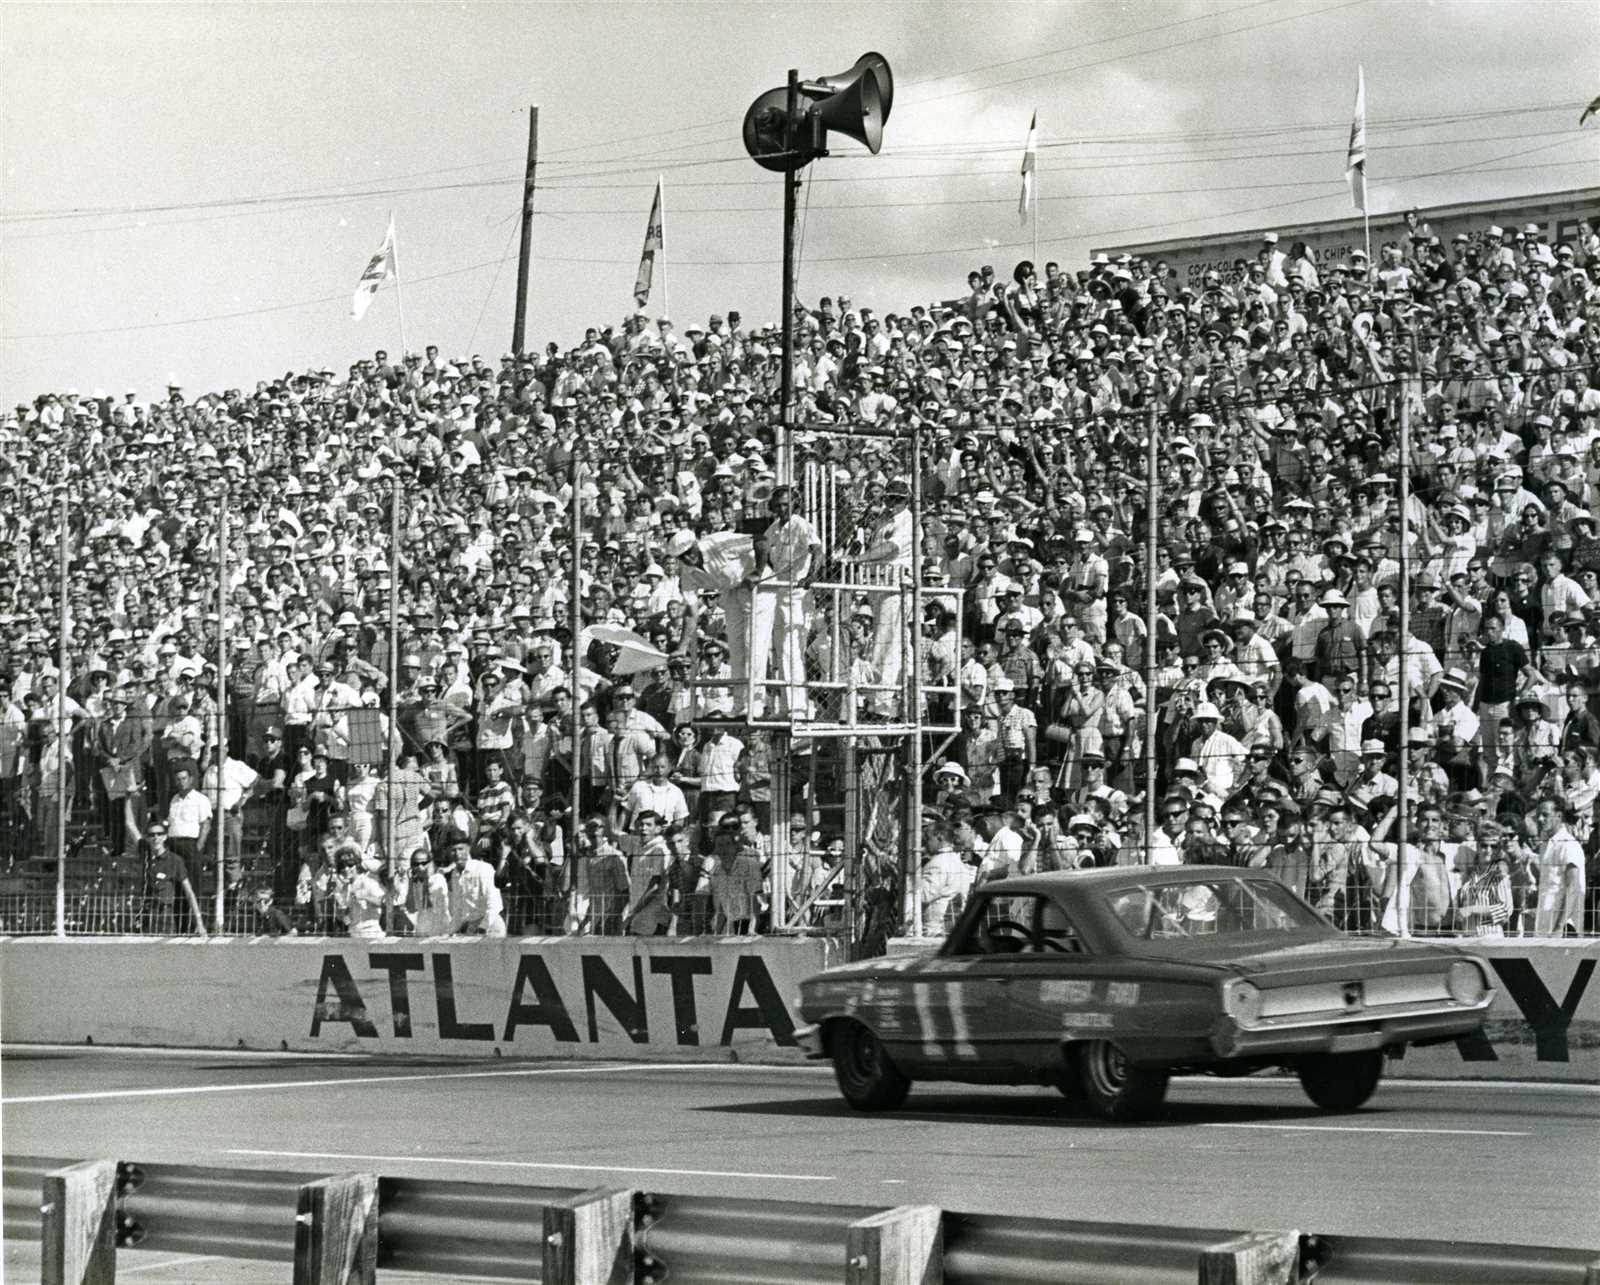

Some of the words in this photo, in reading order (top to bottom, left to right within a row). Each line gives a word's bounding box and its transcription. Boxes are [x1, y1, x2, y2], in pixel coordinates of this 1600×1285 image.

[1188, 260, 1235, 276] COCA-COL
[309, 953, 799, 1046] ATLANTA
[912, 981, 976, 1057] 11
